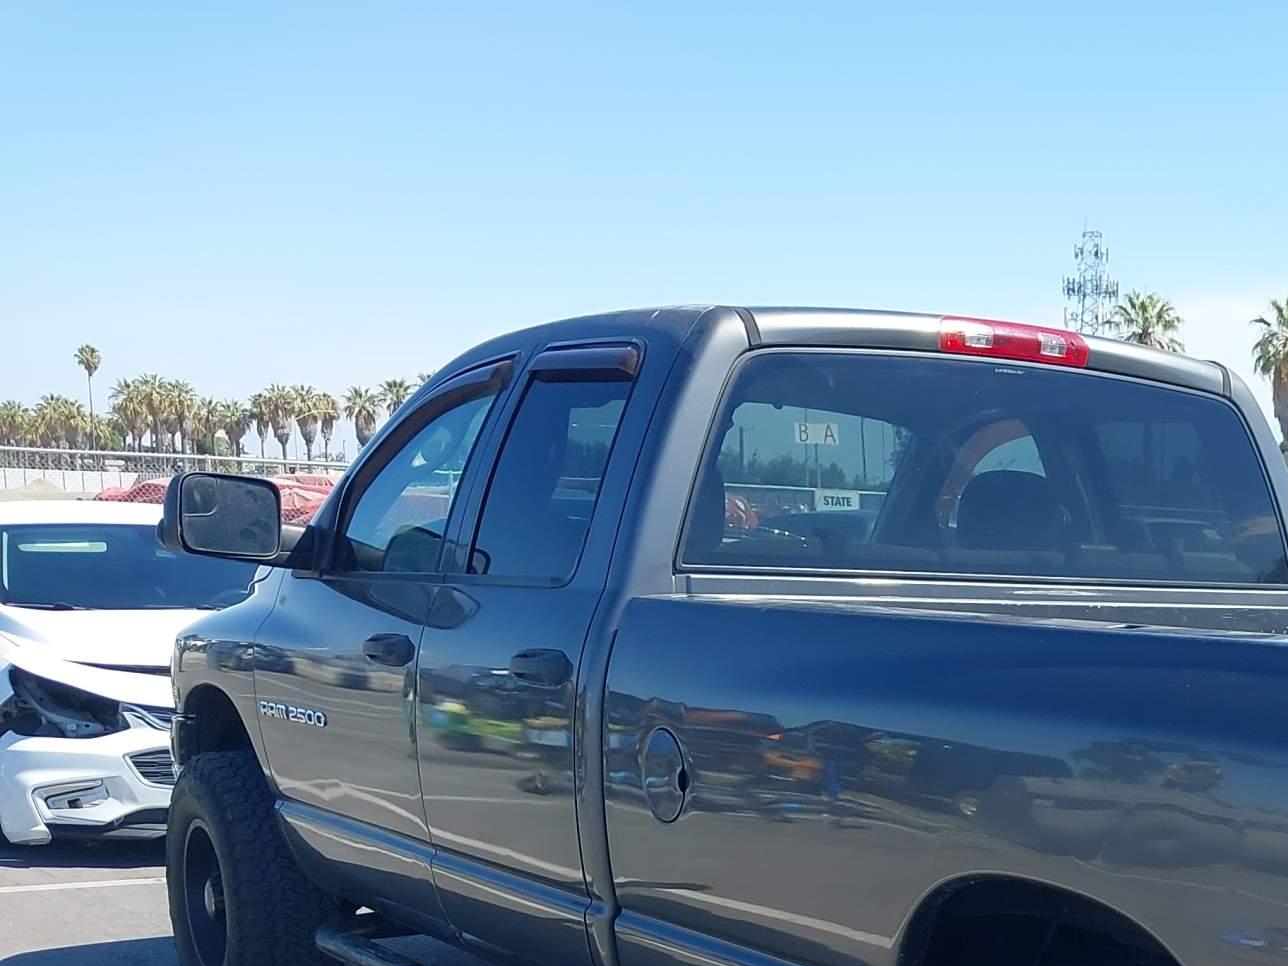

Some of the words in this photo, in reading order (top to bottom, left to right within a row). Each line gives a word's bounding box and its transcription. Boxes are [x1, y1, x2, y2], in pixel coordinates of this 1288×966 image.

[799, 424, 809, 442] B
[824, 424, 837, 443] A
[823, 495, 853, 507] STATE
[260, 701, 288, 720] RAM
[288, 707, 327, 728] 2500
